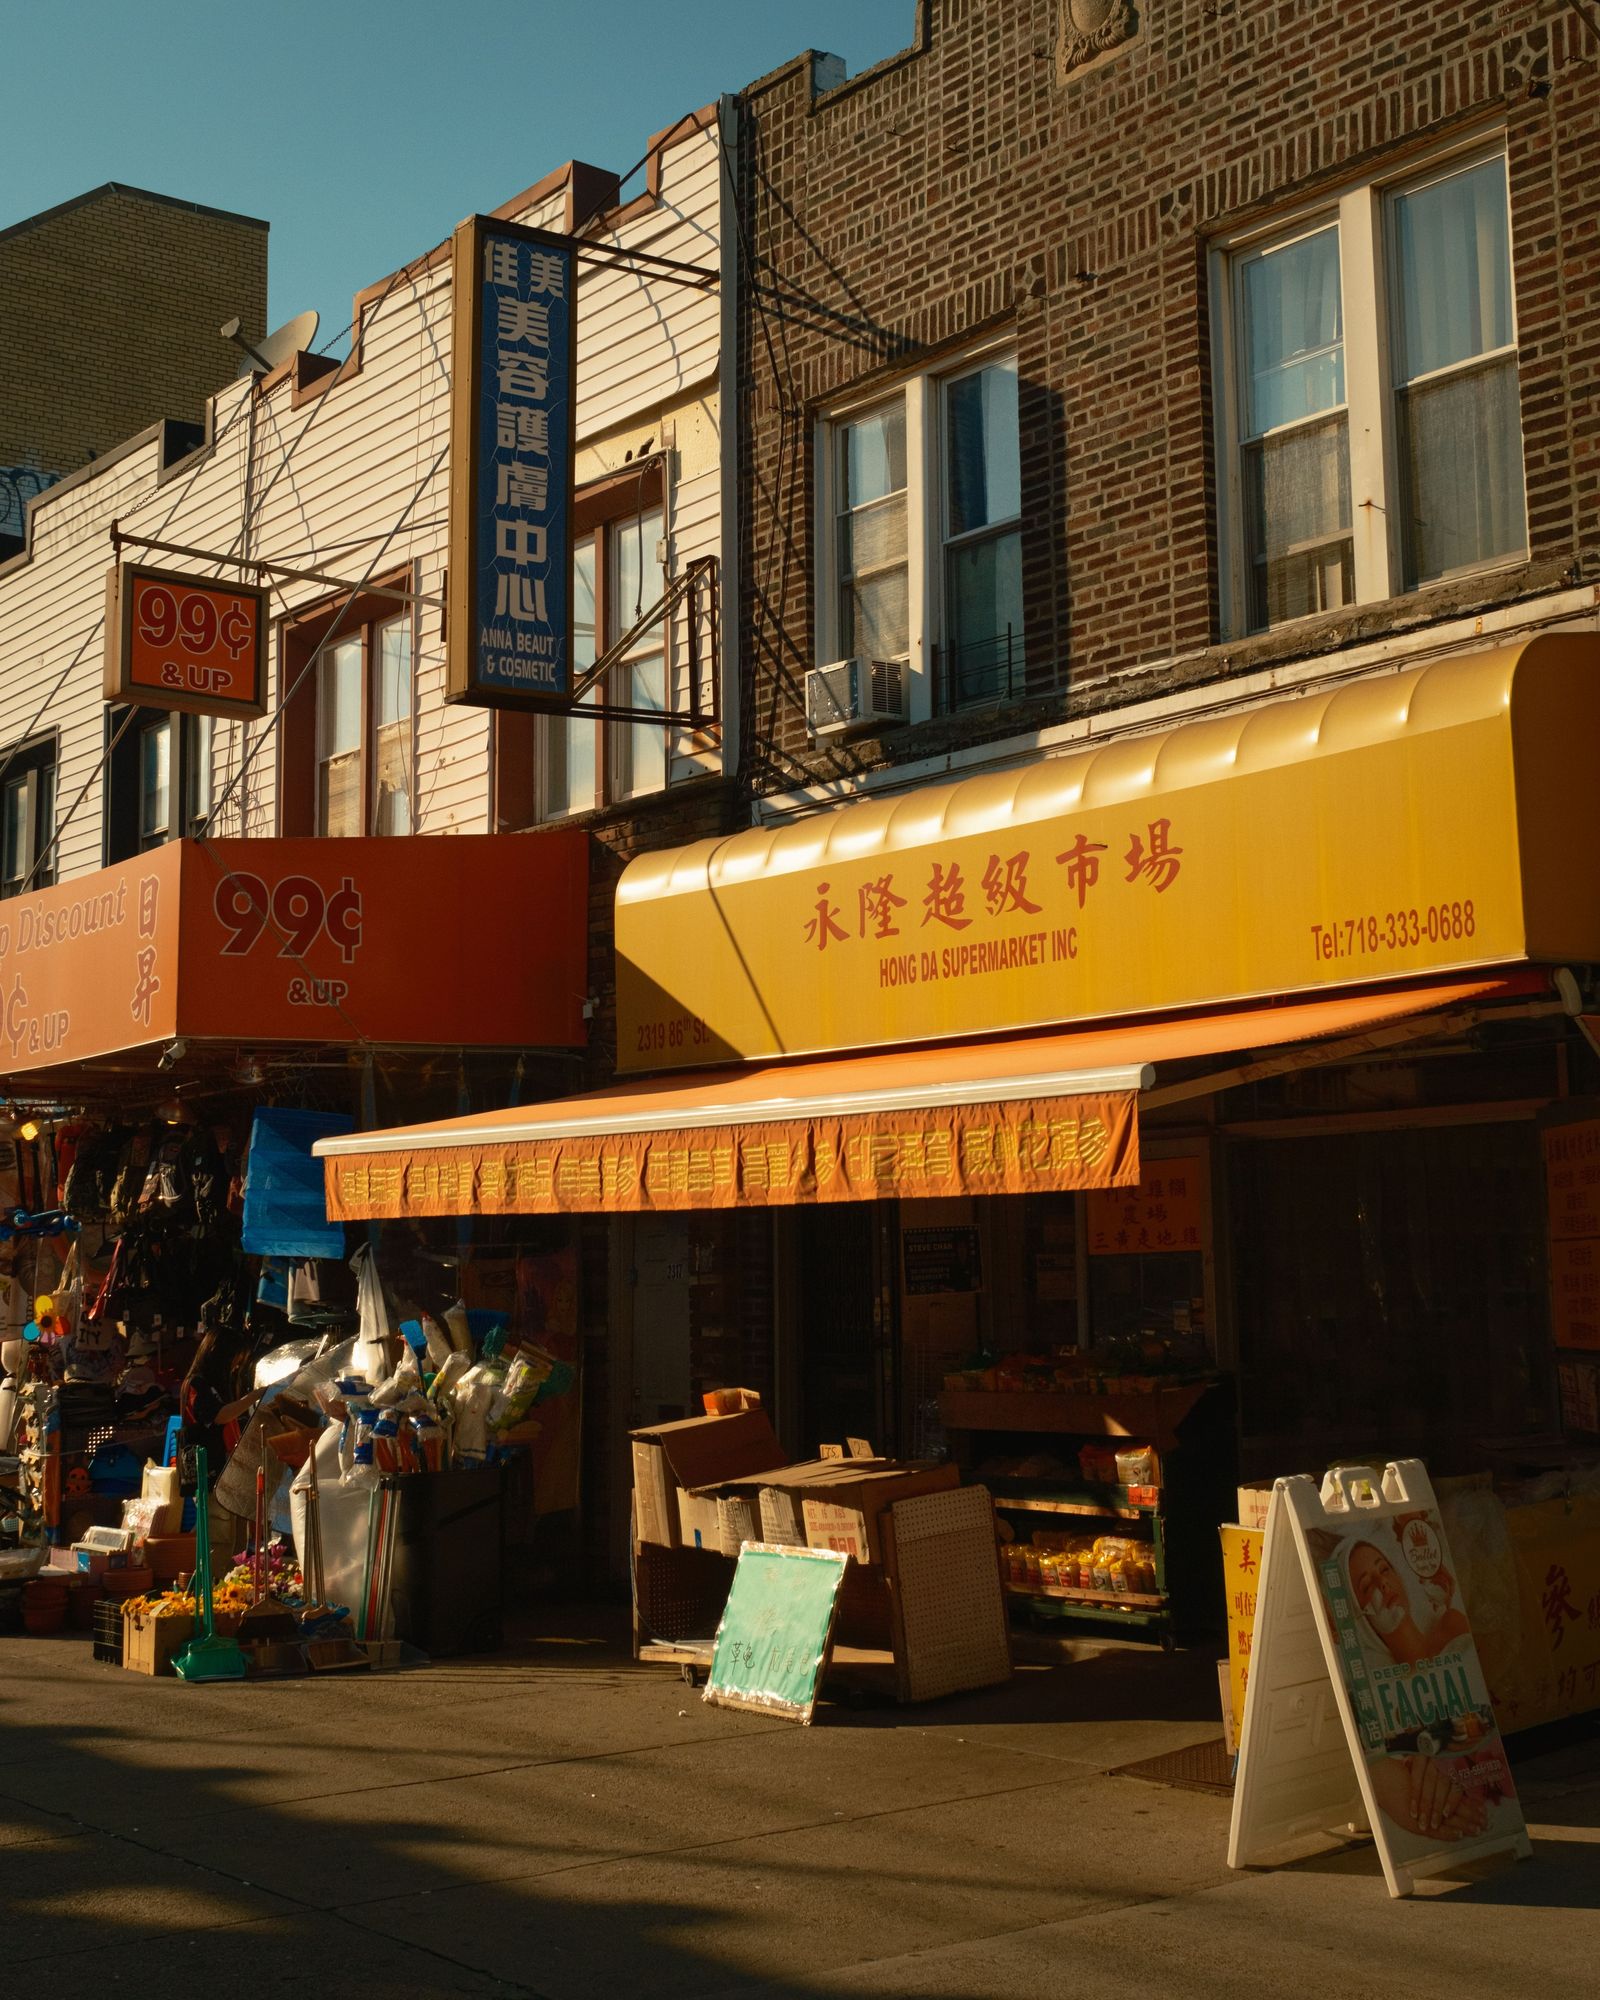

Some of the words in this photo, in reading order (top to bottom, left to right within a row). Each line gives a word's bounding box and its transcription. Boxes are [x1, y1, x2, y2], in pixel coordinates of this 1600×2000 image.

[484, 240, 564, 297] 佳美
[496, 297, 549, 622] 美容護膚中心
[139, 586, 251, 660] 99¢
[481, 627, 513, 650] ANNA
[188, 665, 232, 692] UP
[487, 655, 495, 674] &
[500, 656, 556, 682] COSMETIC
[803, 818, 1183, 951] 永隆超級市場
[16, 877, 128, 954] Discount
[214, 871, 362, 963] 99¢
[880, 952, 917, 987] HONG
[921, 950, 939, 981] DA
[942, 932, 1047, 979] SUPERMARKET
[1052, 927, 1077, 962] INC
[638, 1022, 665, 1052] 2319
[693, 1016, 710, 1045] St.
[1373, 1664, 1410, 1680] DEEP
[1416, 1653, 1462, 1670] CLEAN
[1376, 1666, 1481, 1730] FACIAL
